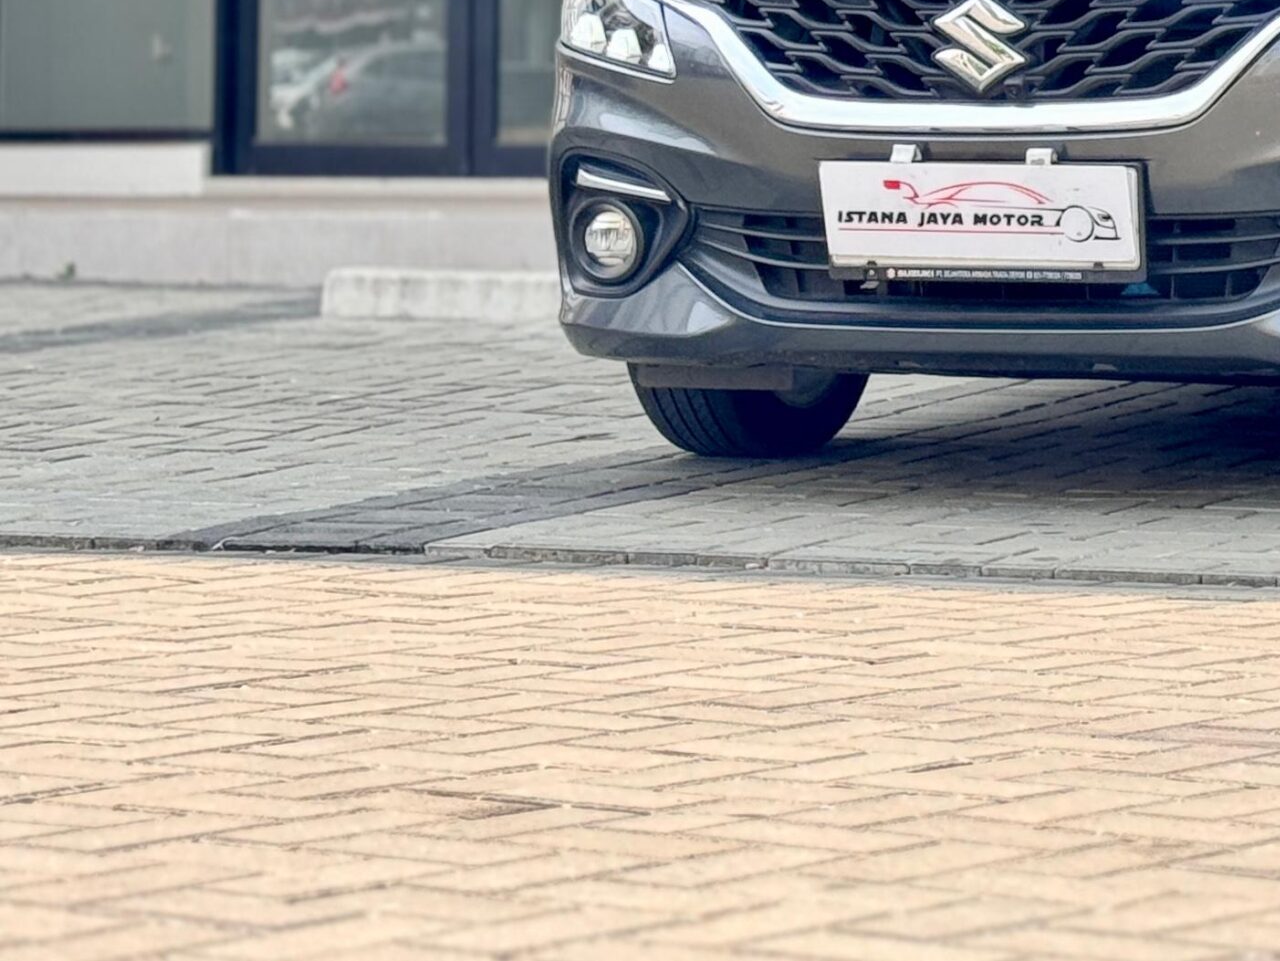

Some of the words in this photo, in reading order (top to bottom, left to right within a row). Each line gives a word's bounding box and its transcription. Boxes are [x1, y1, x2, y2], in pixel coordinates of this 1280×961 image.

[838, 210, 907, 225] ISTANA
[917, 212, 965, 227] JAYA
[973, 213, 1045, 227] MOTOR
